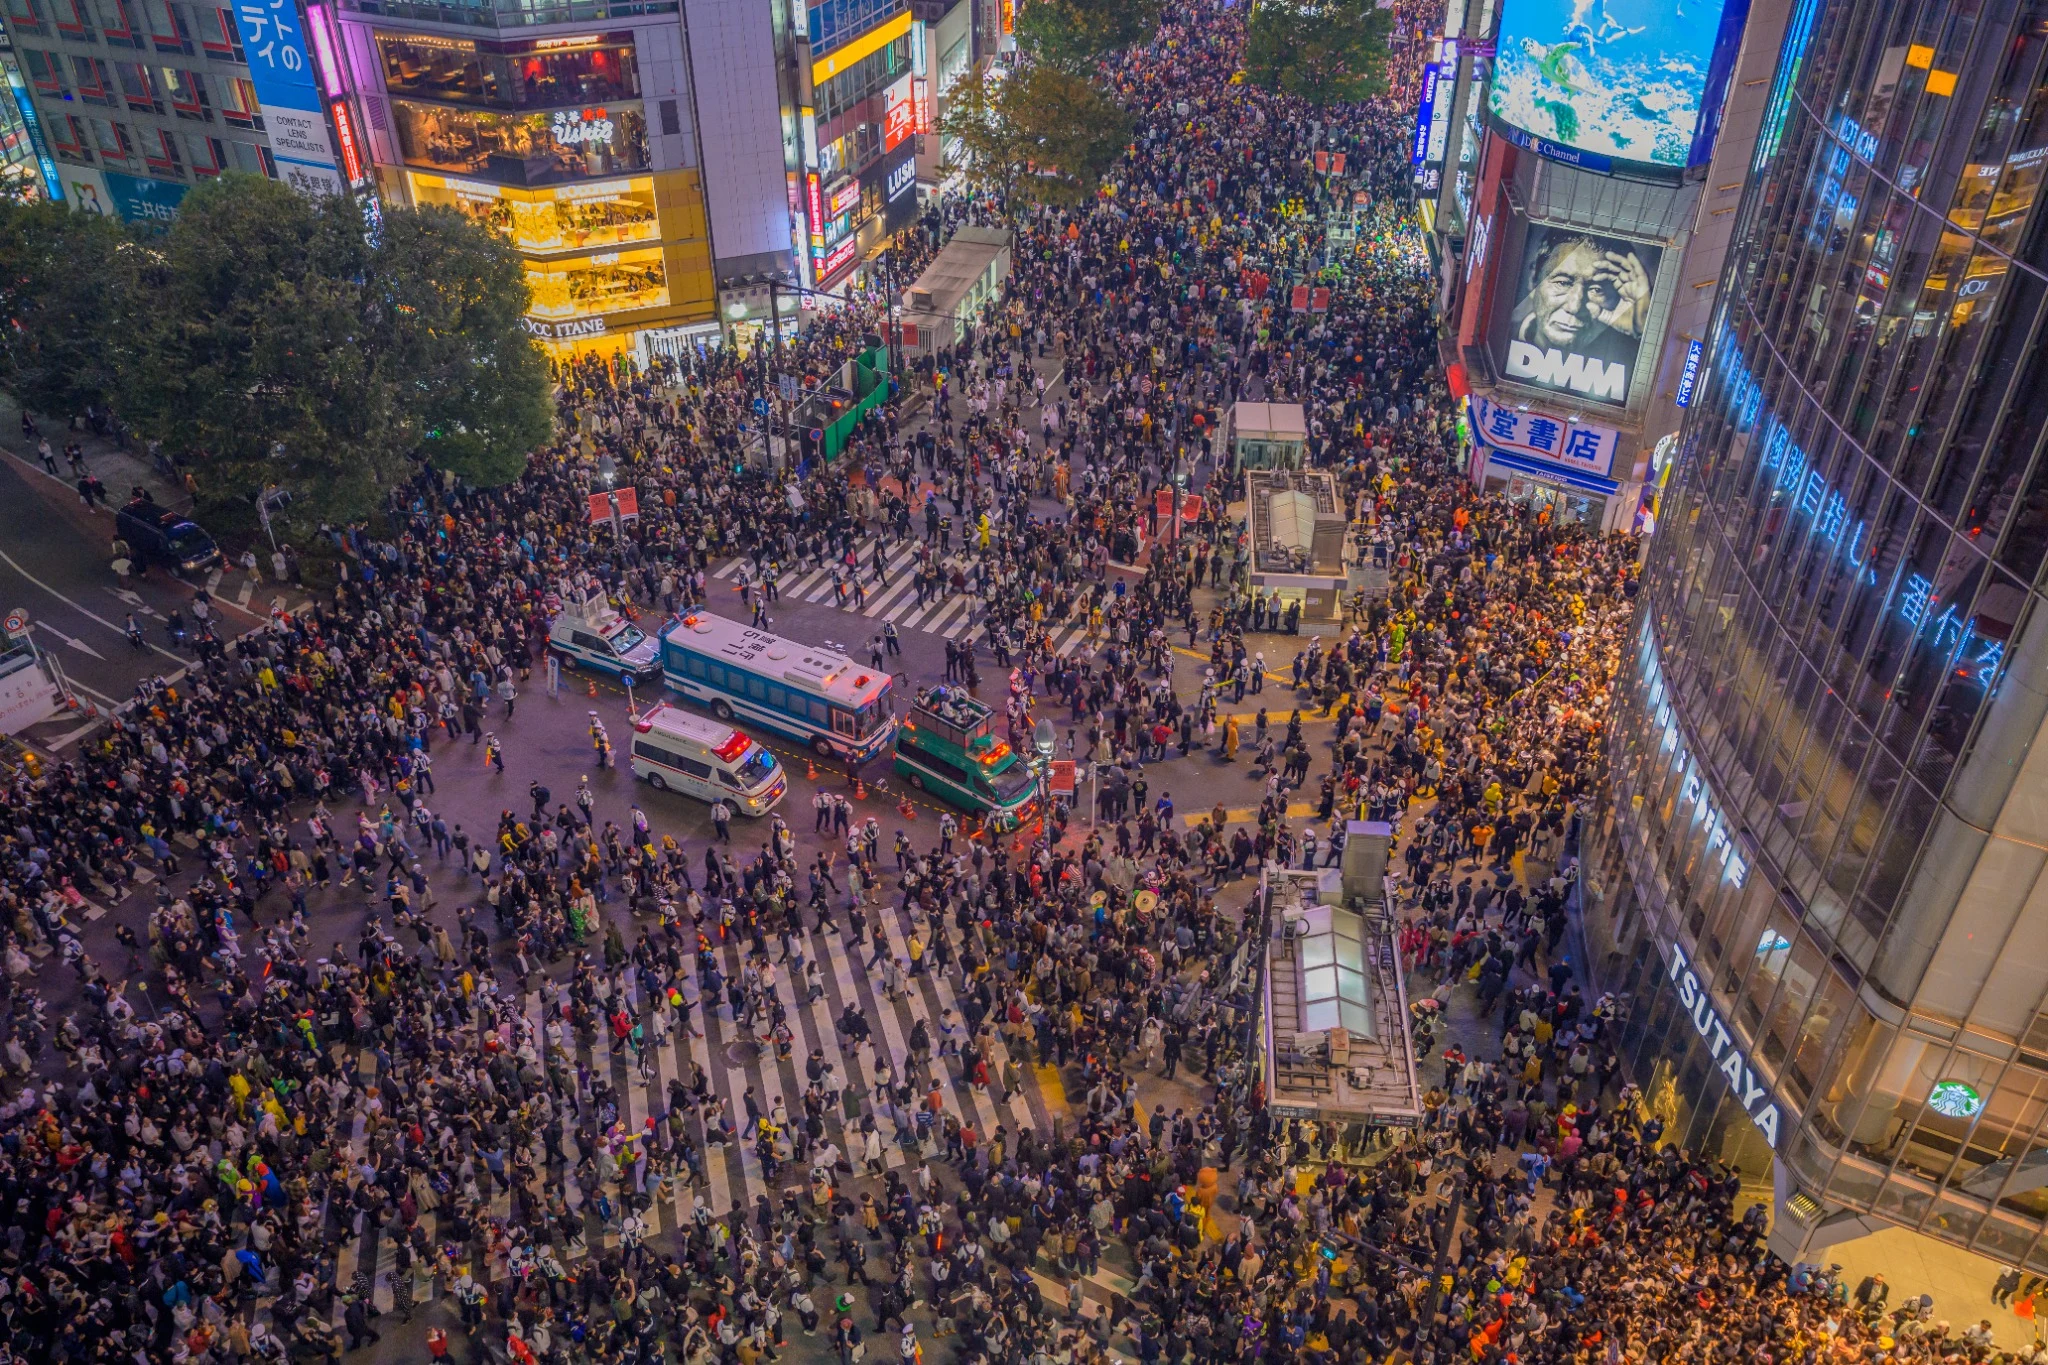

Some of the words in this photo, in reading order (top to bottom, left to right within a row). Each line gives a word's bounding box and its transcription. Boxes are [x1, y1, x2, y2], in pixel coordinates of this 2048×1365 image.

[1425, 70, 1436, 103] MIZUHO
[276, 115, 313, 130] CONTACT
[287, 128, 308, 140] LENS
[275, 137, 326, 154] SPECIALISTS
[1543, 143, 1581, 164] Channel
[888, 157, 916, 196] LUSH
[1505, 339, 1625, 402] DMM
[1535, 470, 1568, 483] TAISEIDO
[1670, 942, 1780, 1148] TSUTAYA
